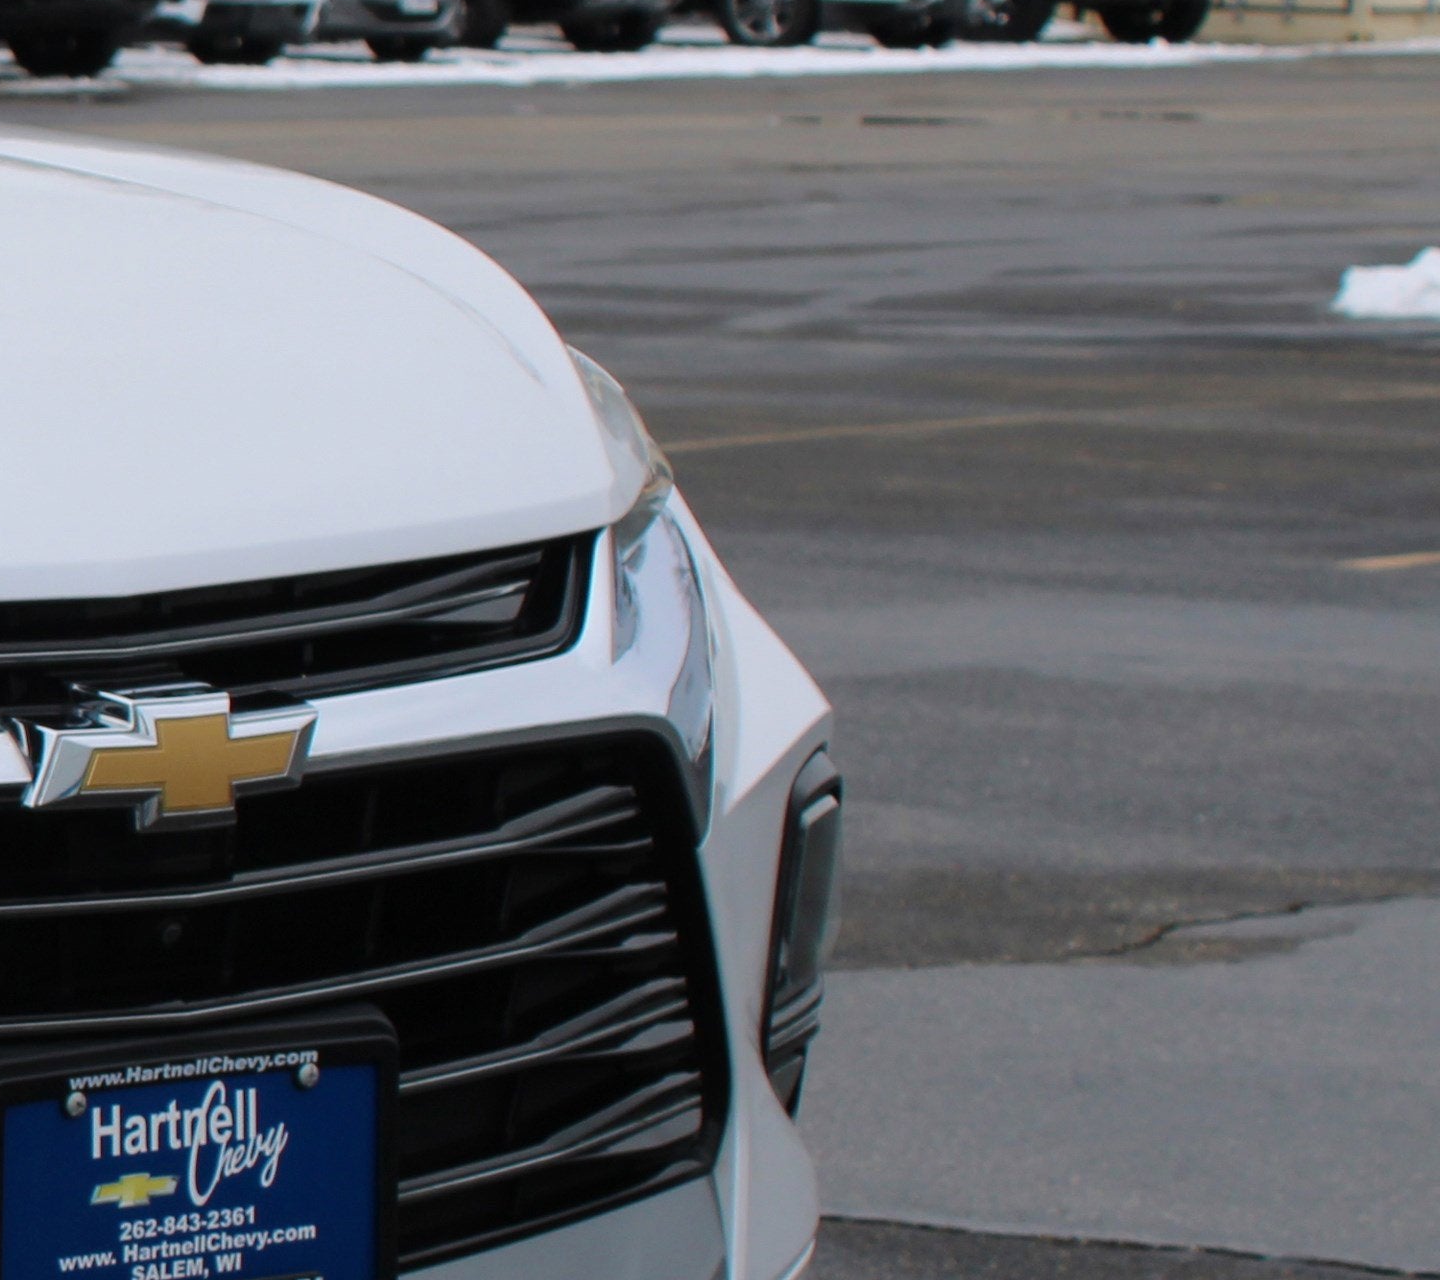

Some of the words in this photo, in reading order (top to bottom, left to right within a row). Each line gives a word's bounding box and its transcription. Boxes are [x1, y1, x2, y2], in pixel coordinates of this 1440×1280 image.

[69, 1050, 319, 1090] www.HartnellChevy.com
[91, 1087, 257, 1160] Hartnell
[188, 1080, 289, 1206] Chevy
[119, 1206, 256, 1242] 262-843-2361
[122, 1224, 317, 1264] HartnellChevy.com
[215, 1252, 243, 1272] WI
